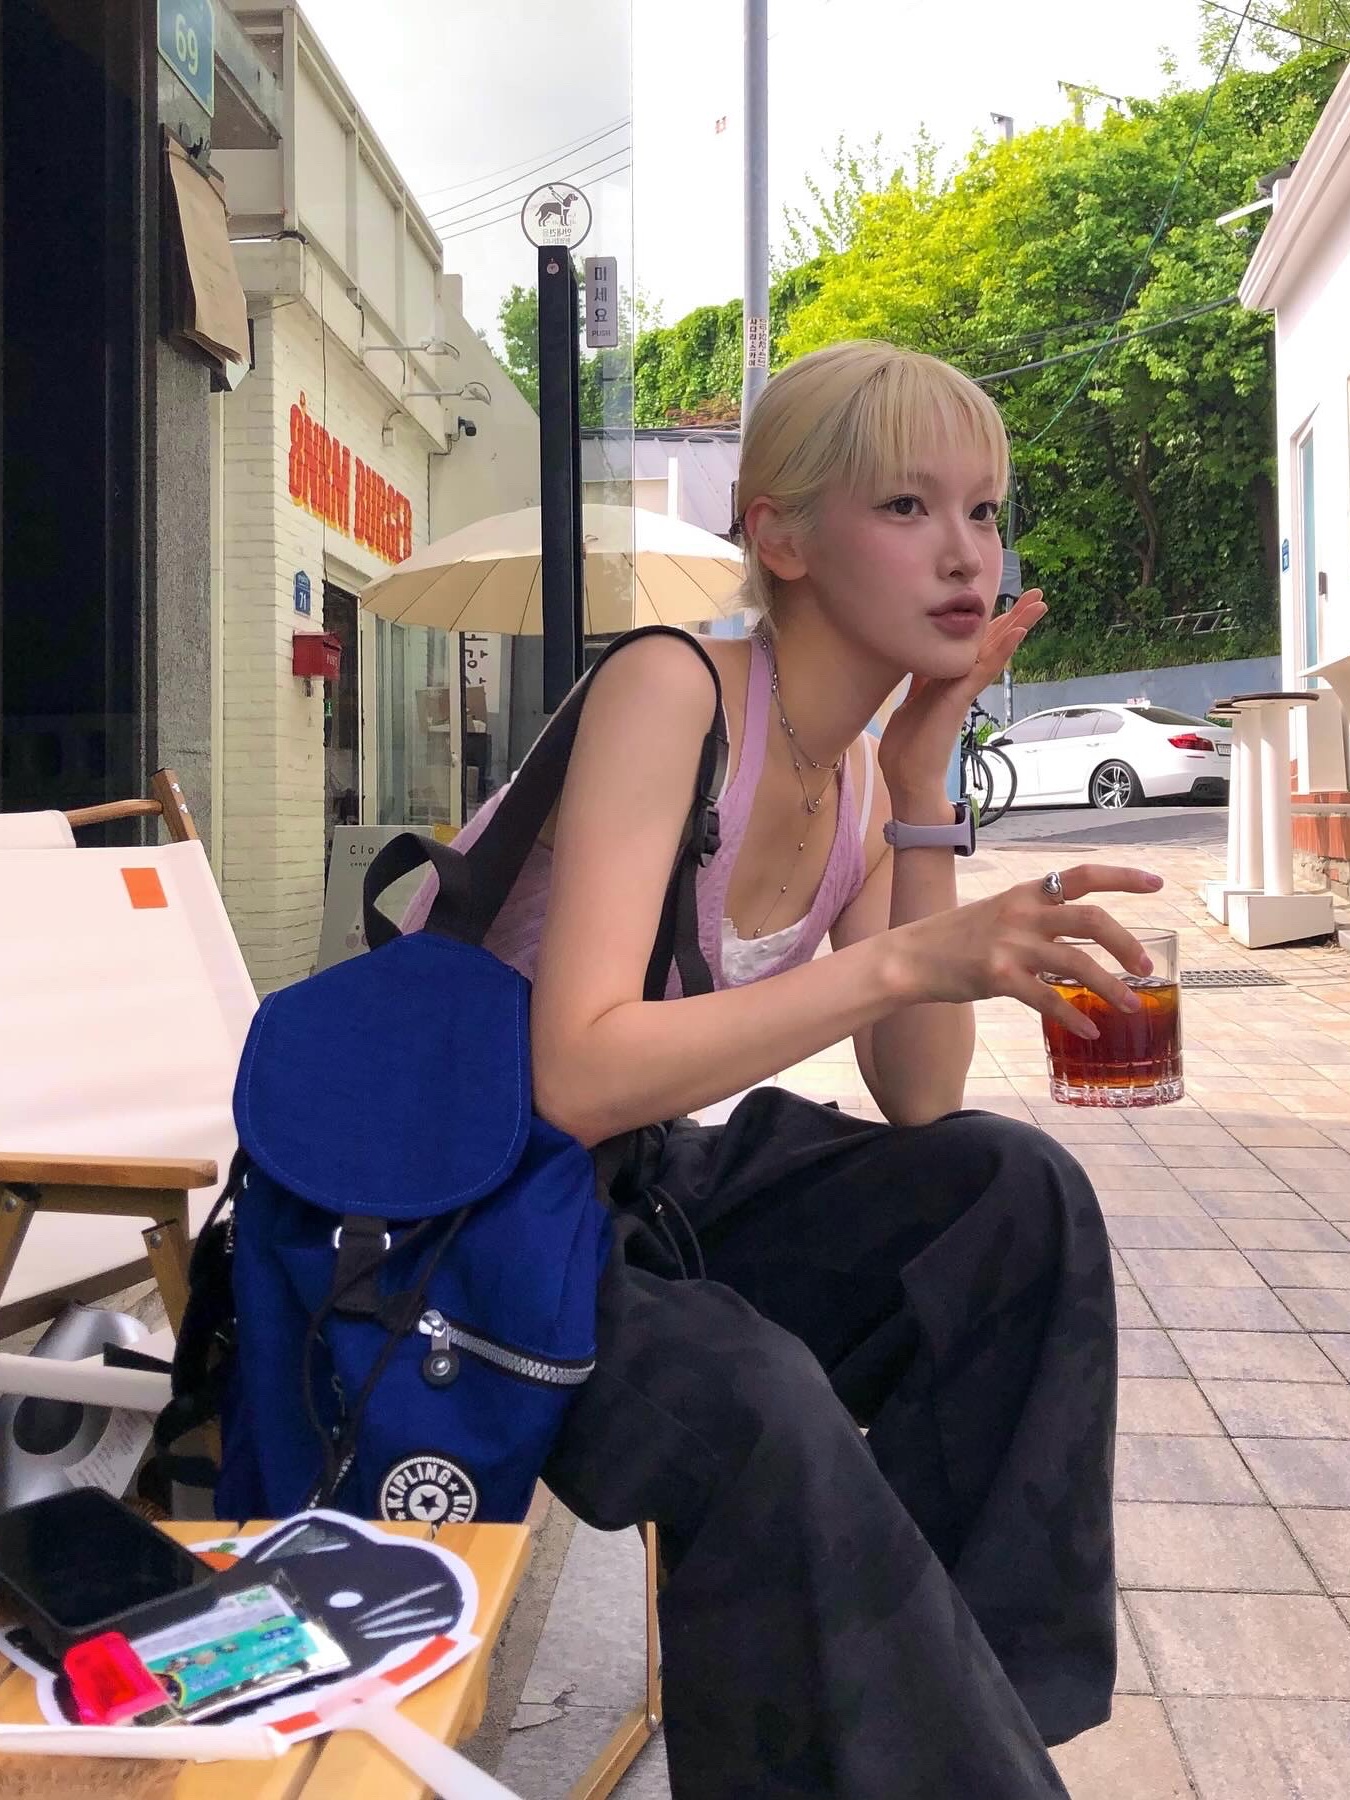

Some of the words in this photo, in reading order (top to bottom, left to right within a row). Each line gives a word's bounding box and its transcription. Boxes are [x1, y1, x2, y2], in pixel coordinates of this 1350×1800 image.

[175, 13, 199, 76] 69
[591, 329, 612, 338] PUSH
[353, 455, 413, 567] BURGER
[299, 592, 307, 611] 71
[387, 1463, 452, 1509] KIPLING
